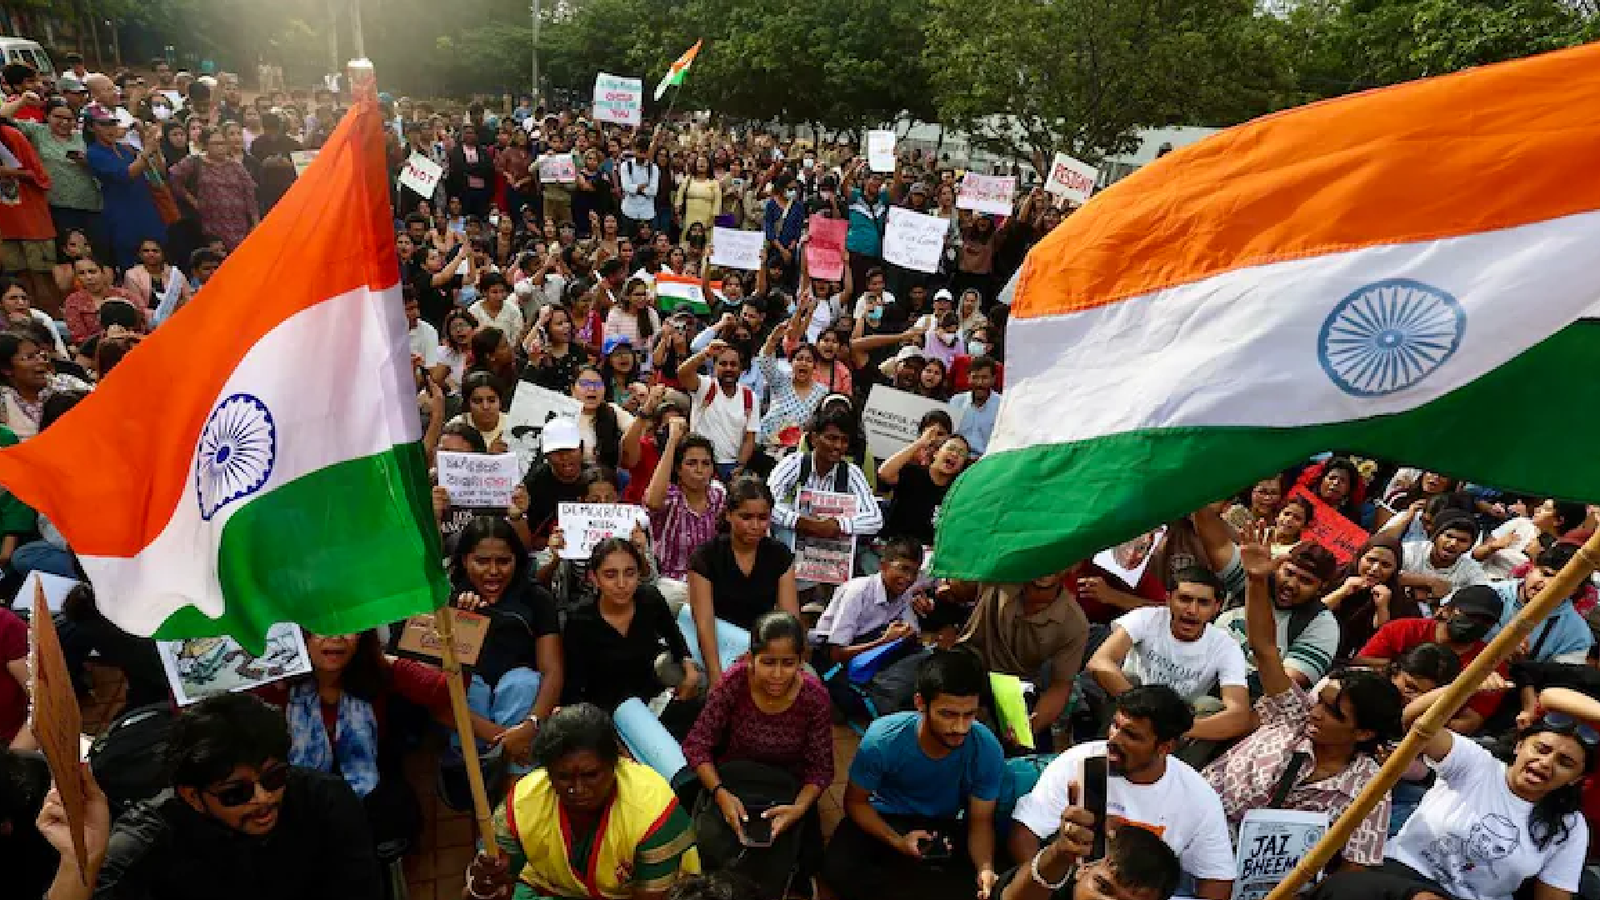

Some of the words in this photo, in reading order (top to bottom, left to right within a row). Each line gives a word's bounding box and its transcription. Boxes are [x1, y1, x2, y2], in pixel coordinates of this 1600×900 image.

[408, 165, 436, 184] NOT
[562, 504, 630, 520] DEMOCRACY
[1251, 834, 1293, 858] JAI
[1241, 856, 1300, 880] BHEEM
